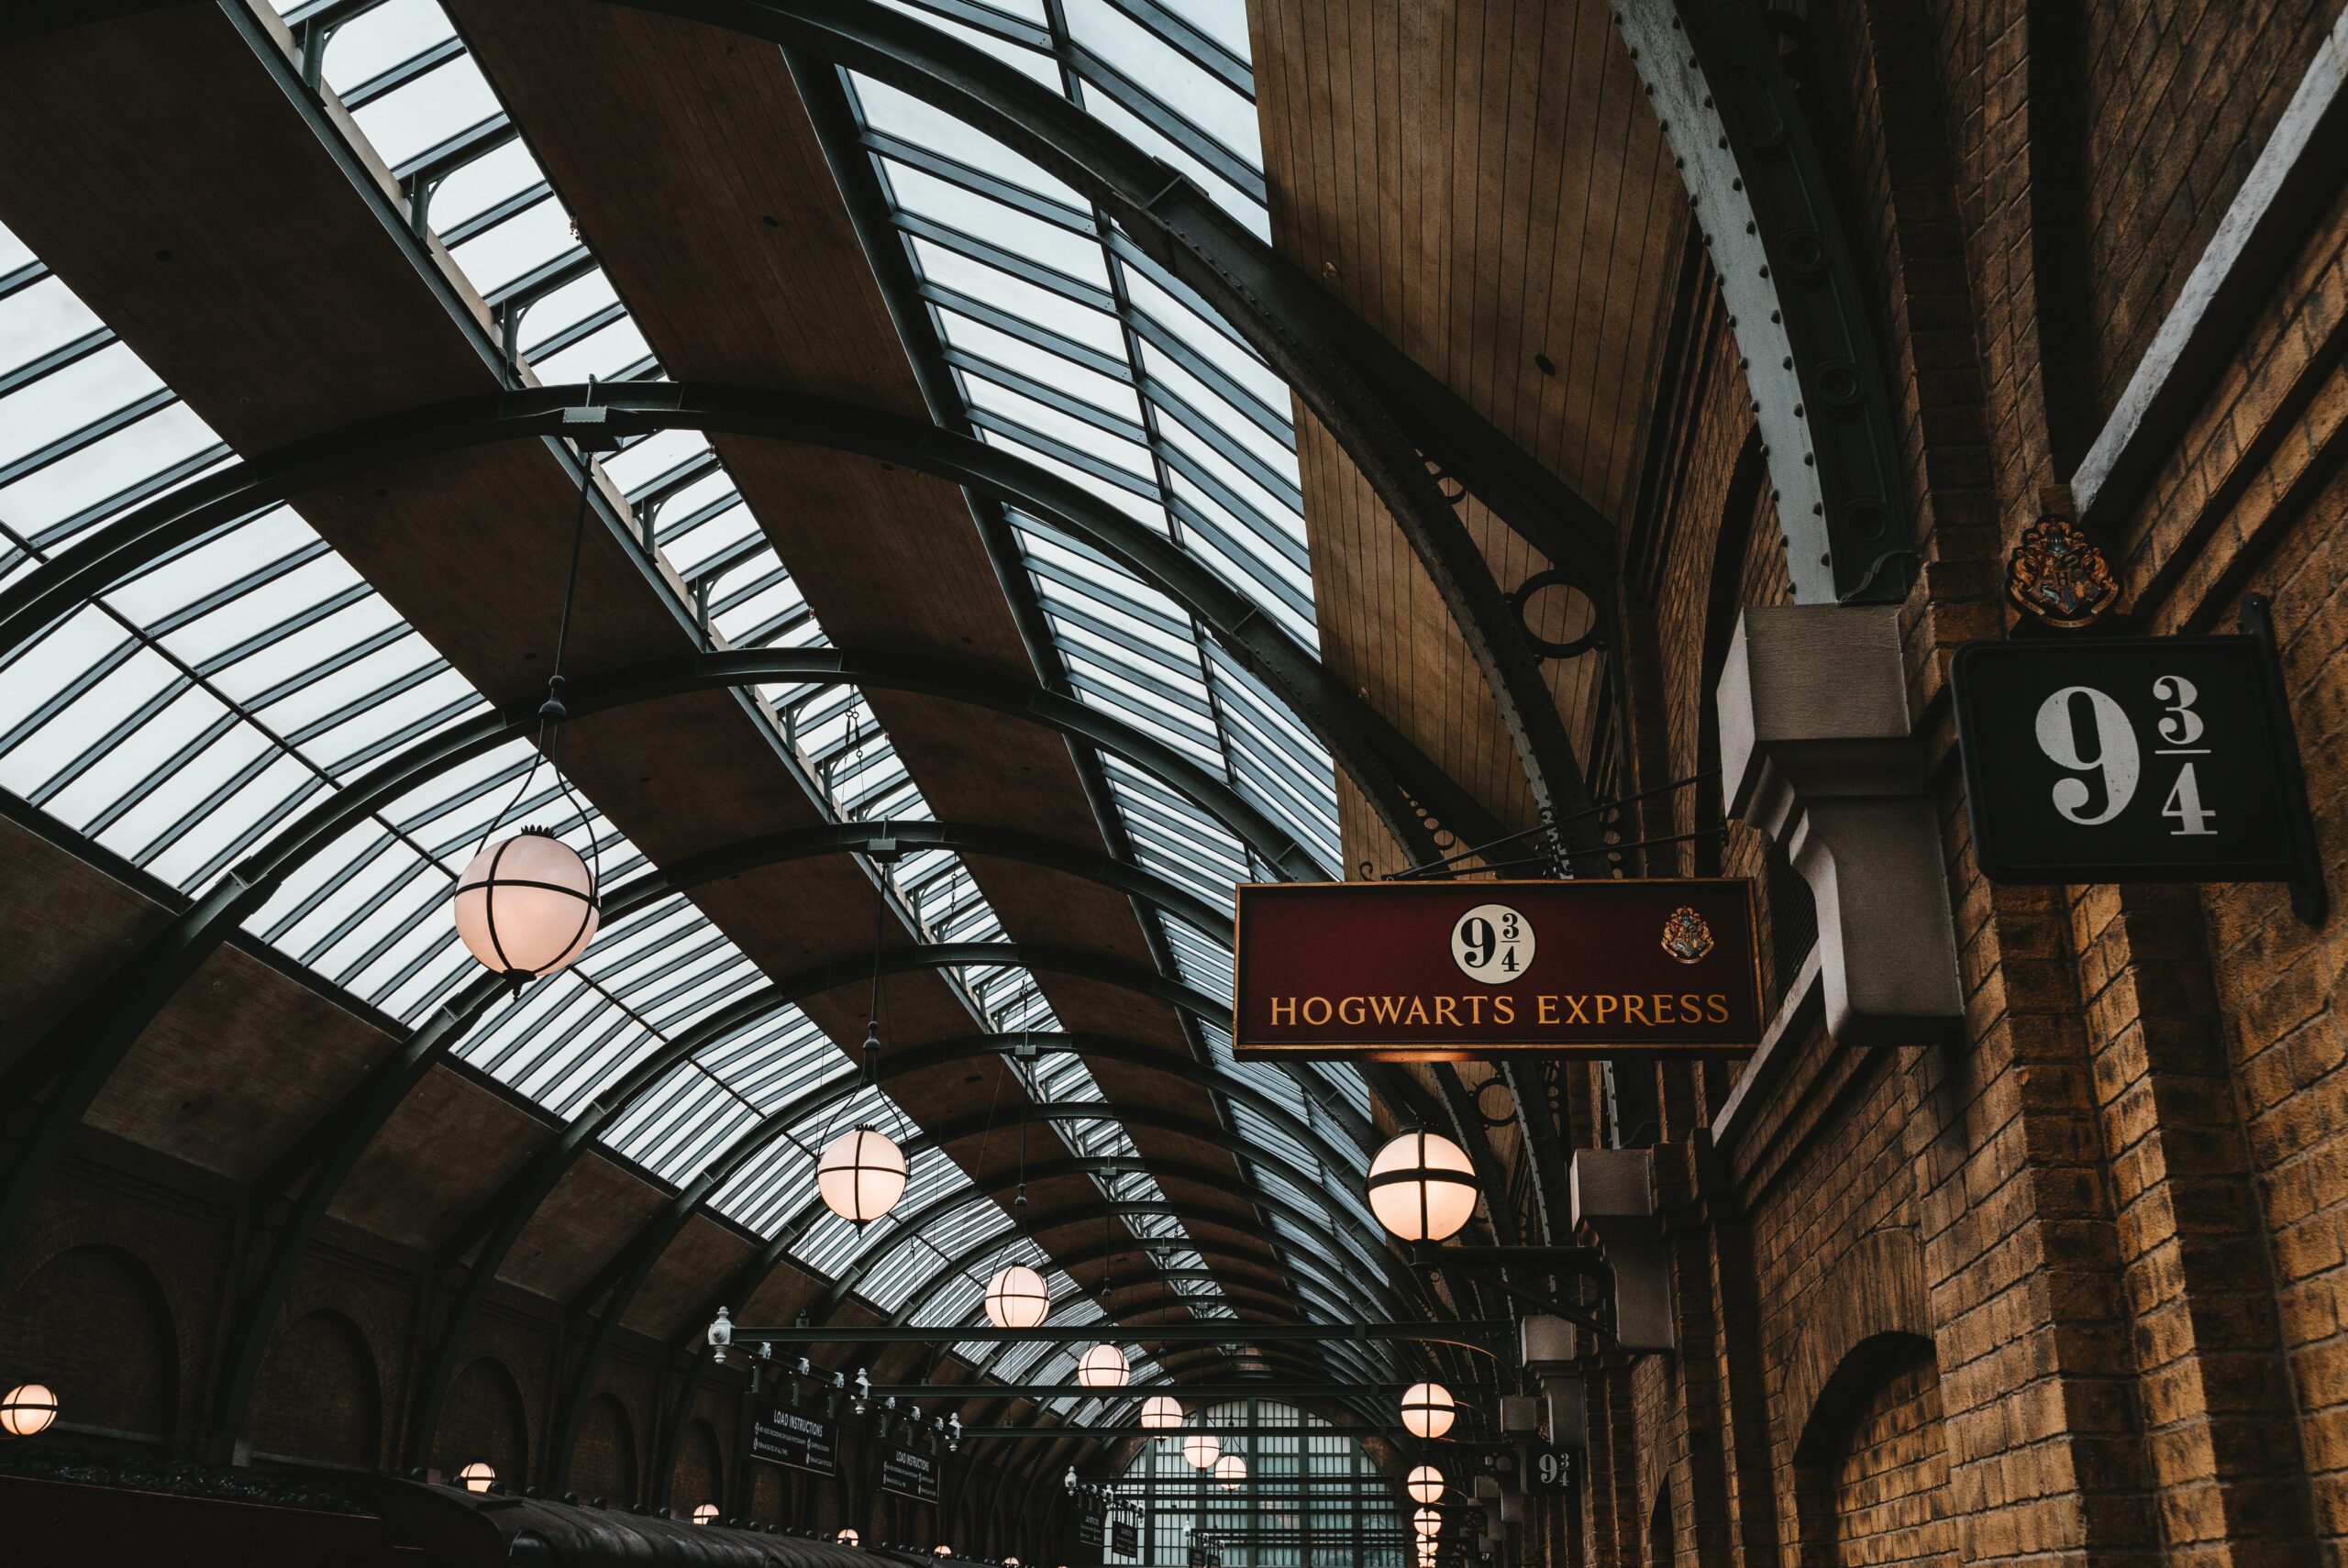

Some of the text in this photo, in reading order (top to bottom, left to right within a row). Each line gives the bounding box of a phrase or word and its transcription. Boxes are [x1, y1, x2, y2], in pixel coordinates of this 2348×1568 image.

[1270, 993, 1730, 1026] HOGWARTS EXPRESS
[773, 1408, 789, 1427] LOAD
[789, 1414, 823, 1438] INSTRUCTIONS
